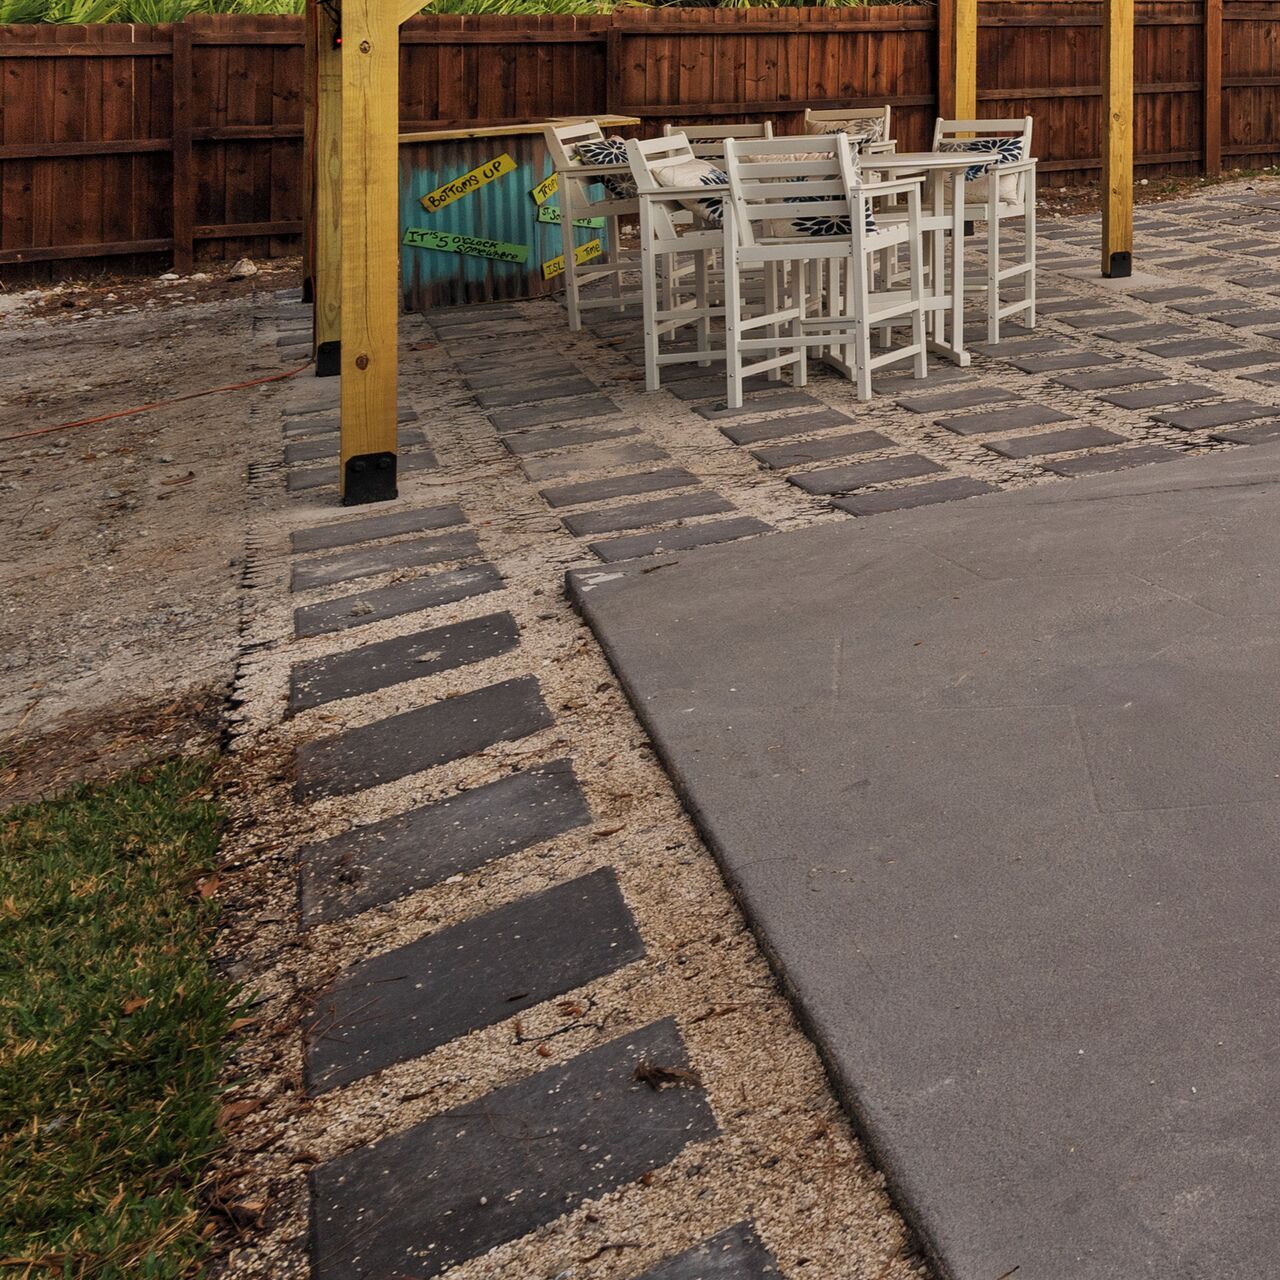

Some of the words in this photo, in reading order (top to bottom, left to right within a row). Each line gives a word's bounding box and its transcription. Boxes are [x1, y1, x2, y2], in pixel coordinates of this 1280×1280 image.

[483, 160, 502, 179] UP
[408, 231, 439, 243] IT'S
[436, 236, 449, 248] 5
